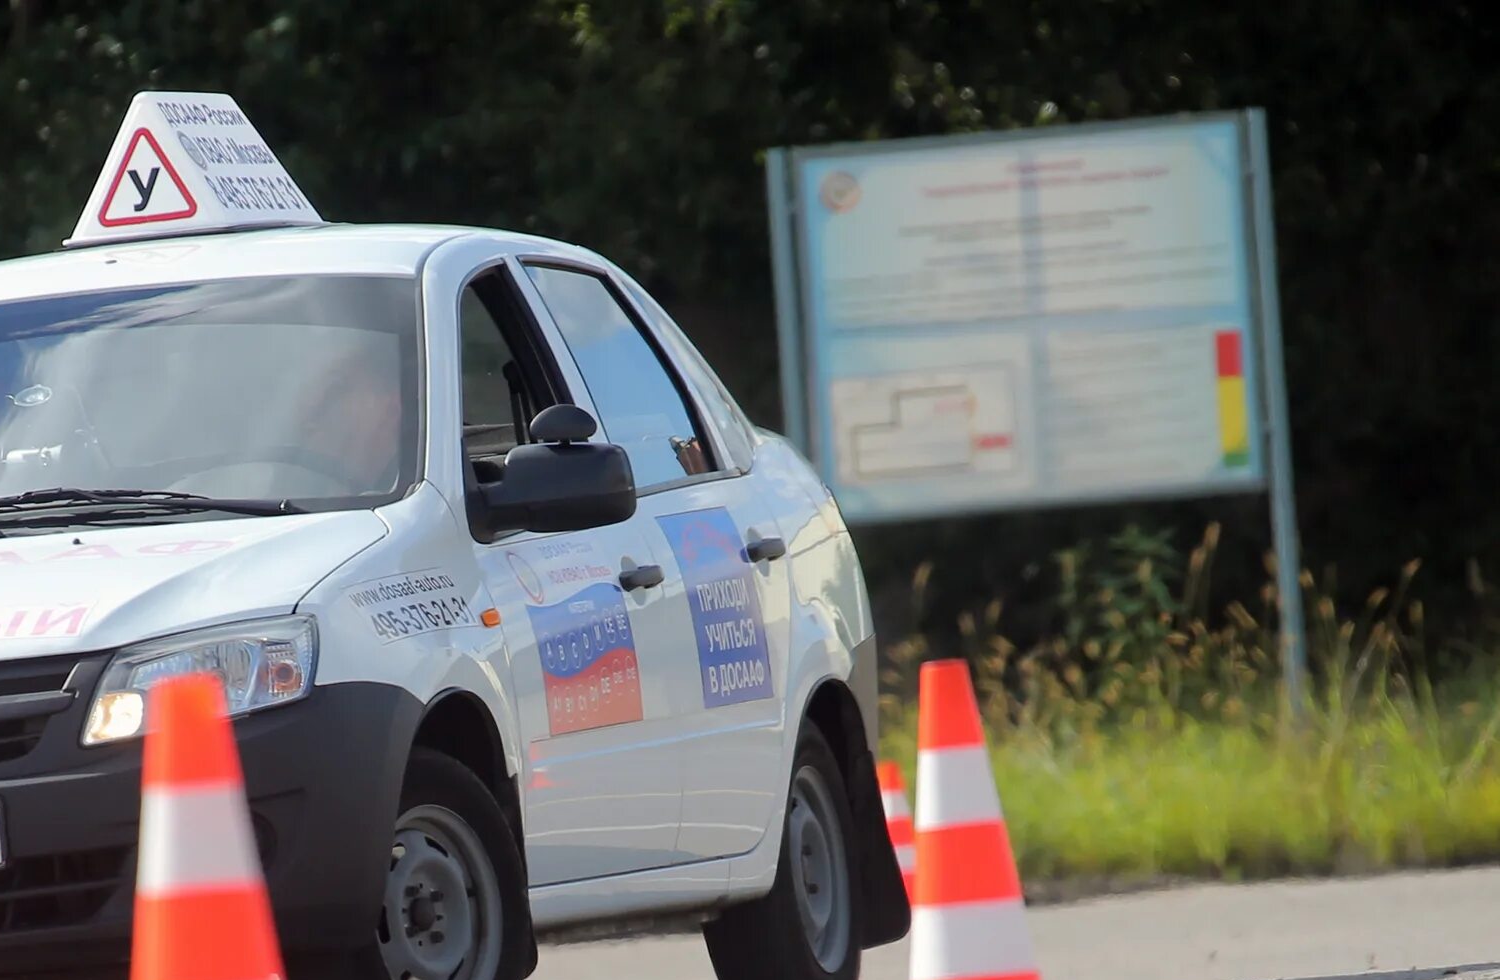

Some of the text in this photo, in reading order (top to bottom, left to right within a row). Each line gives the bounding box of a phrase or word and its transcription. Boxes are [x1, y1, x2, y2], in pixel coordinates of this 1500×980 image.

[157, 102, 247, 128] ДОСААФ России
[126, 167, 161, 212] У
[204, 175, 308, 210] 8-495-376-21-31
[349, 574, 454, 607] www.dosaaf-auto.ru
[696, 577, 749, 612] ПРИХОДИ
[370, 596, 477, 639] 495-376-21-31
[705, 618, 757, 652] УЧИТЬСЯ
[709, 659, 765, 697] В ДОСААФ
